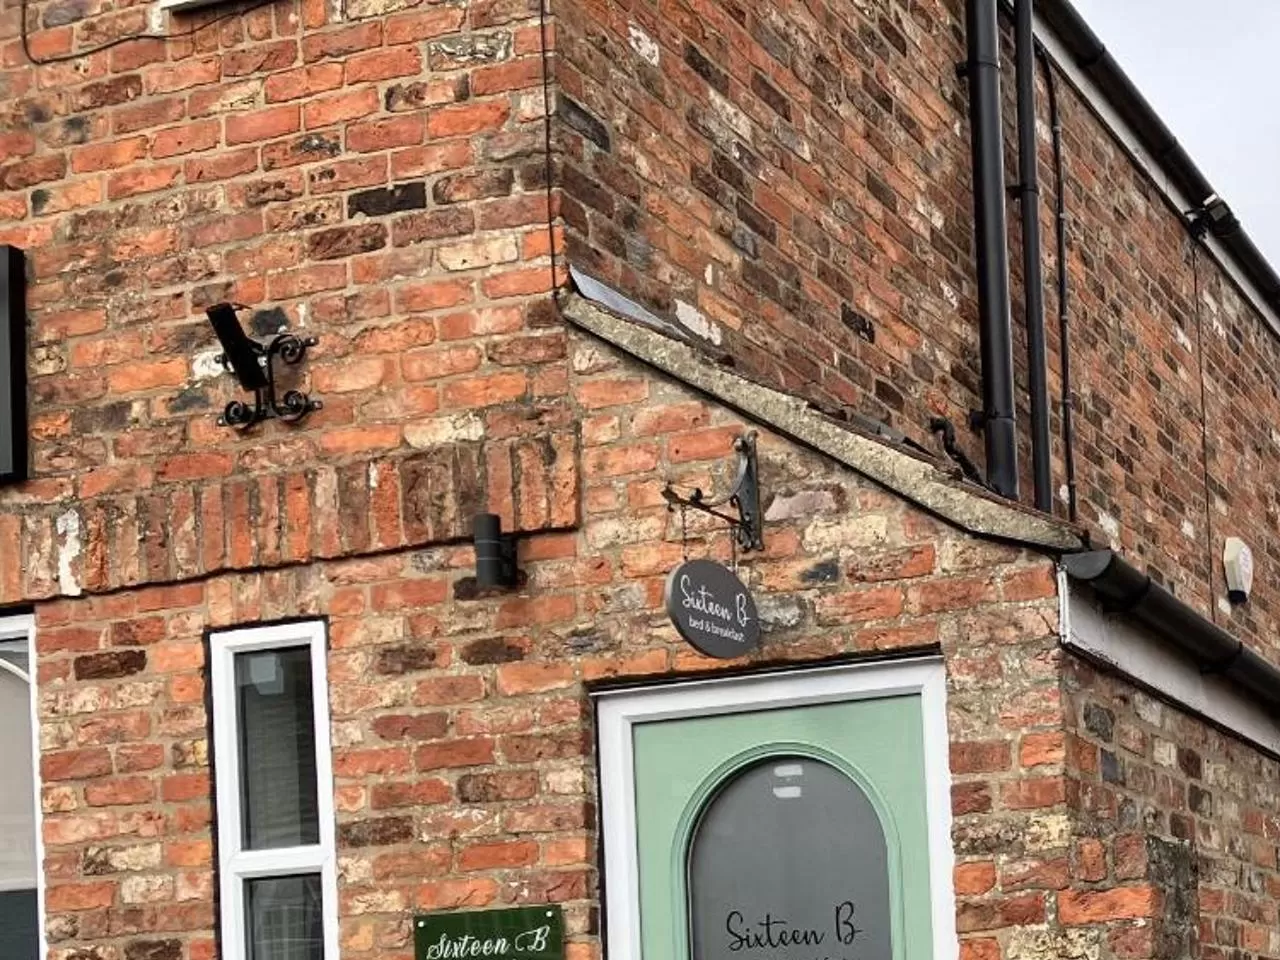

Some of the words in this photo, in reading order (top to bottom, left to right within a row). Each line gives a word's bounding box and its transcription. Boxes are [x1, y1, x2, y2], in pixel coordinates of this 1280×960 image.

[680, 574, 733, 621] Sixteen
[736, 592, 751, 628] B
[688, 614, 704, 631] bed
[426, 933, 511, 960] Sixteen
[514, 924, 550, 951] B
[725, 910, 825, 951] Sixteen
[835, 900, 863, 945] B
